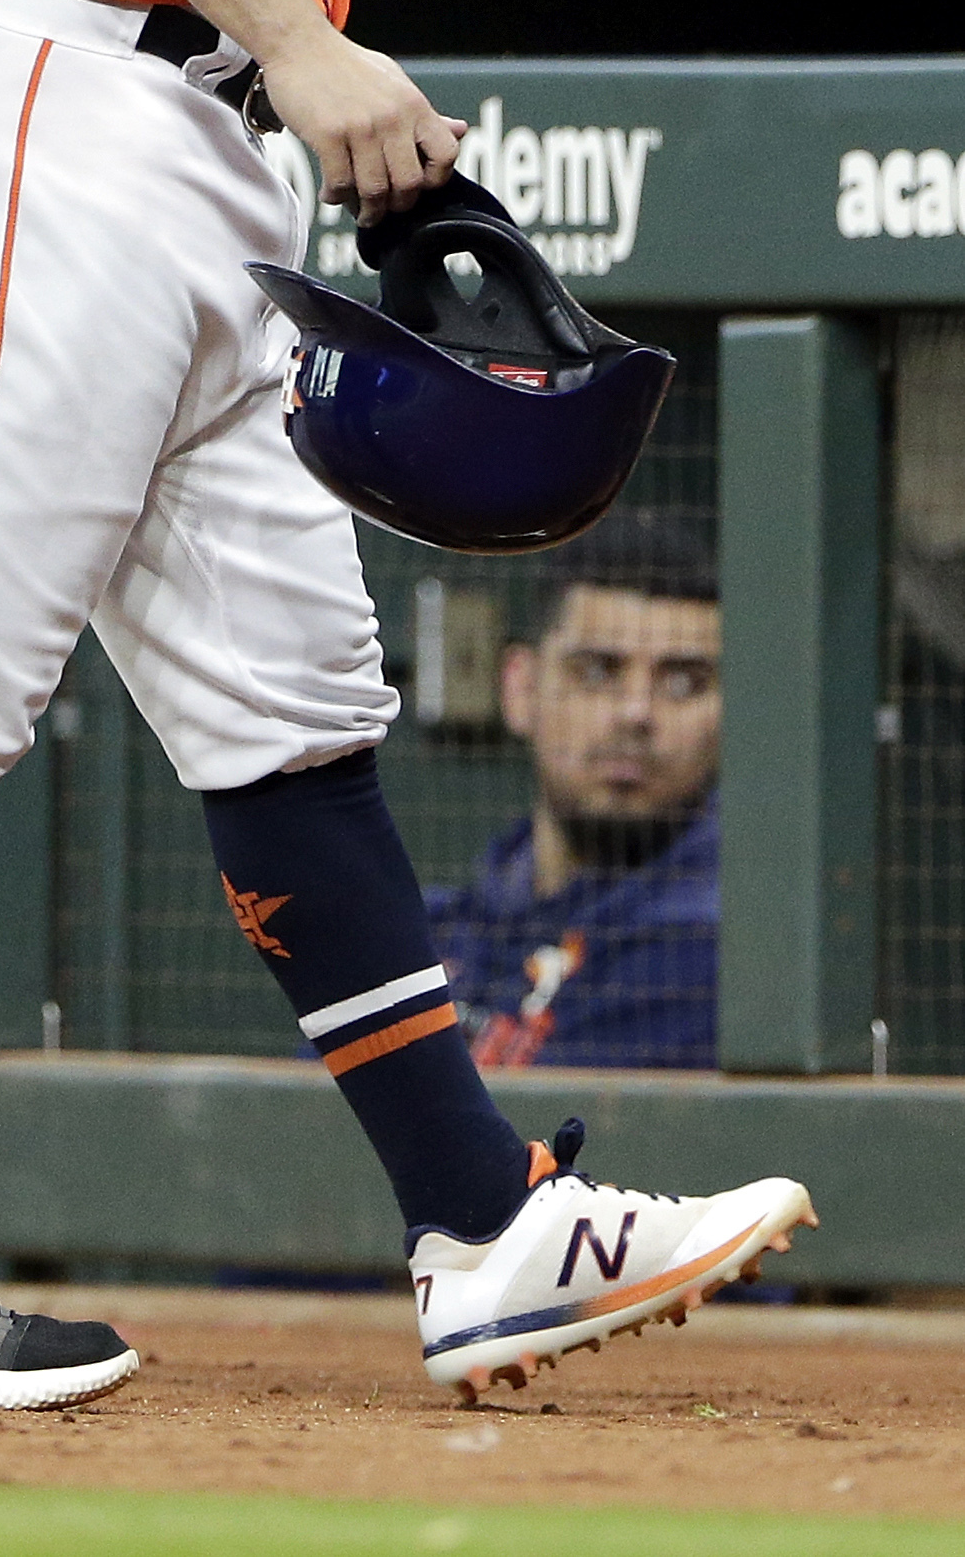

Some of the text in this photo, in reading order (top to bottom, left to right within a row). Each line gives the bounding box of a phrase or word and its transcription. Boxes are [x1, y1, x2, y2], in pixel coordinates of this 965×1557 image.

[451, 95, 651, 263] demy
[836, 147, 965, 239] aca
[556, 1210, 639, 1288] N
